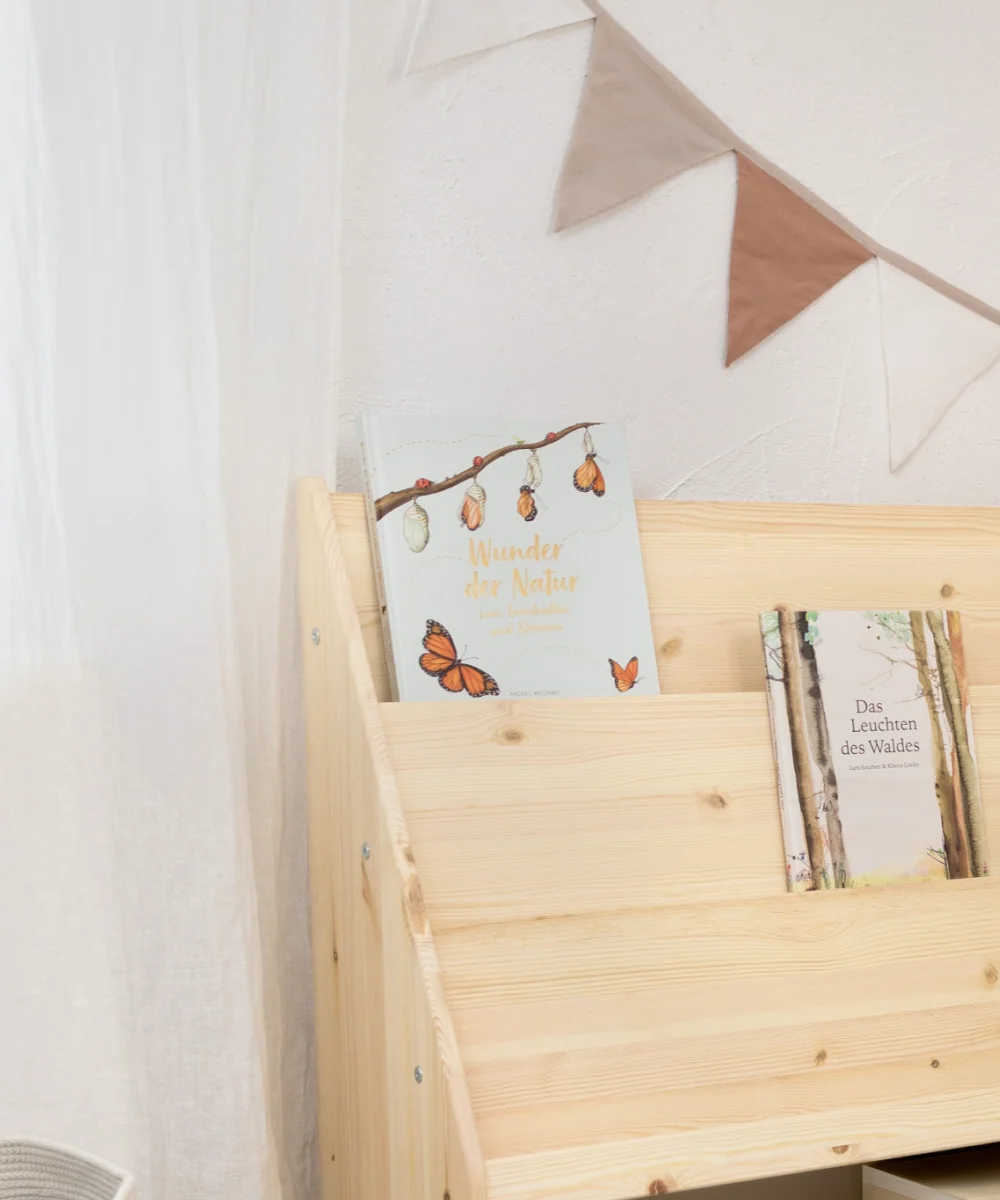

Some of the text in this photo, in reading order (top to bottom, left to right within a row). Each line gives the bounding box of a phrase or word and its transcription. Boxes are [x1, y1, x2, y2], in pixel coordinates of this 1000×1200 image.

[468, 534, 563, 567] Wunder
[464, 568, 579, 600] der Natur
[856, 699, 883, 714] Das
[851, 716, 918, 733] Leuchten
[841, 738, 920, 755] des Waldes
